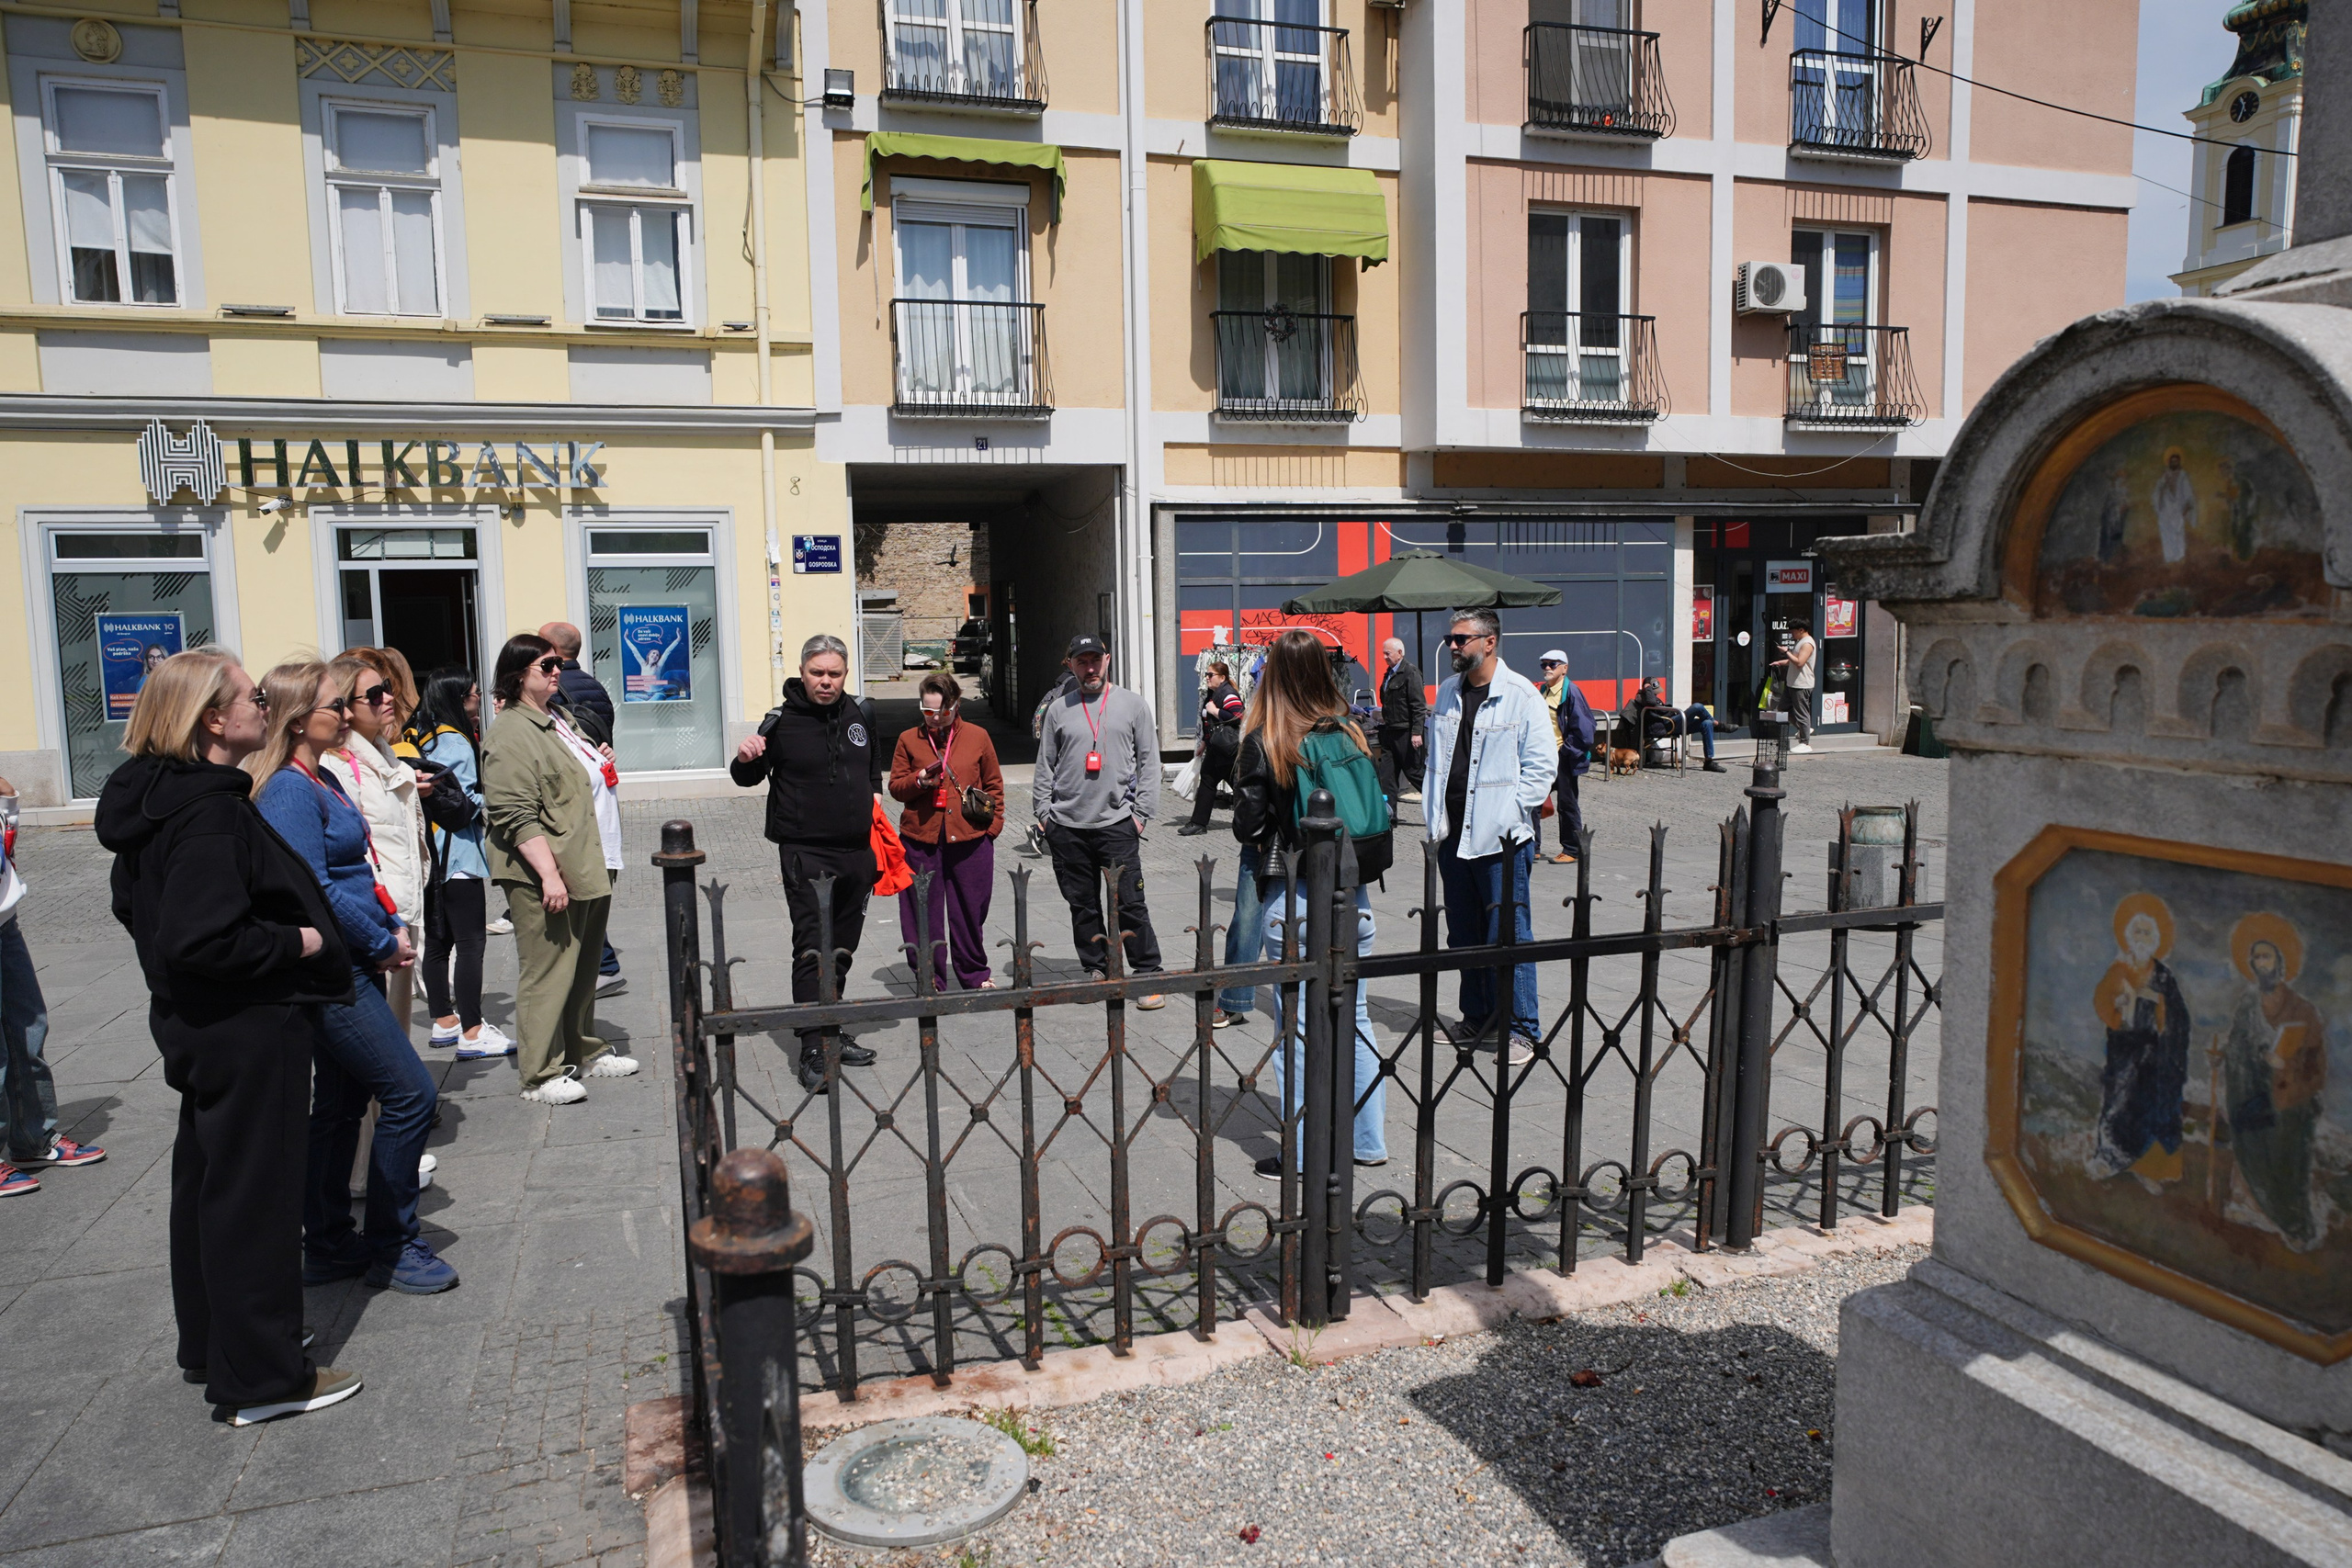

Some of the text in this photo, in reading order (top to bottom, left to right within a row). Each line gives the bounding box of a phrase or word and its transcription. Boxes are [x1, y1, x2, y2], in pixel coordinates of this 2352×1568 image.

[978, 439, 986, 449] 21
[238, 437, 609, 489] HALKBANK
[1781, 570, 1807, 581] MAXI
[635, 615, 683, 623] HALKBANK
